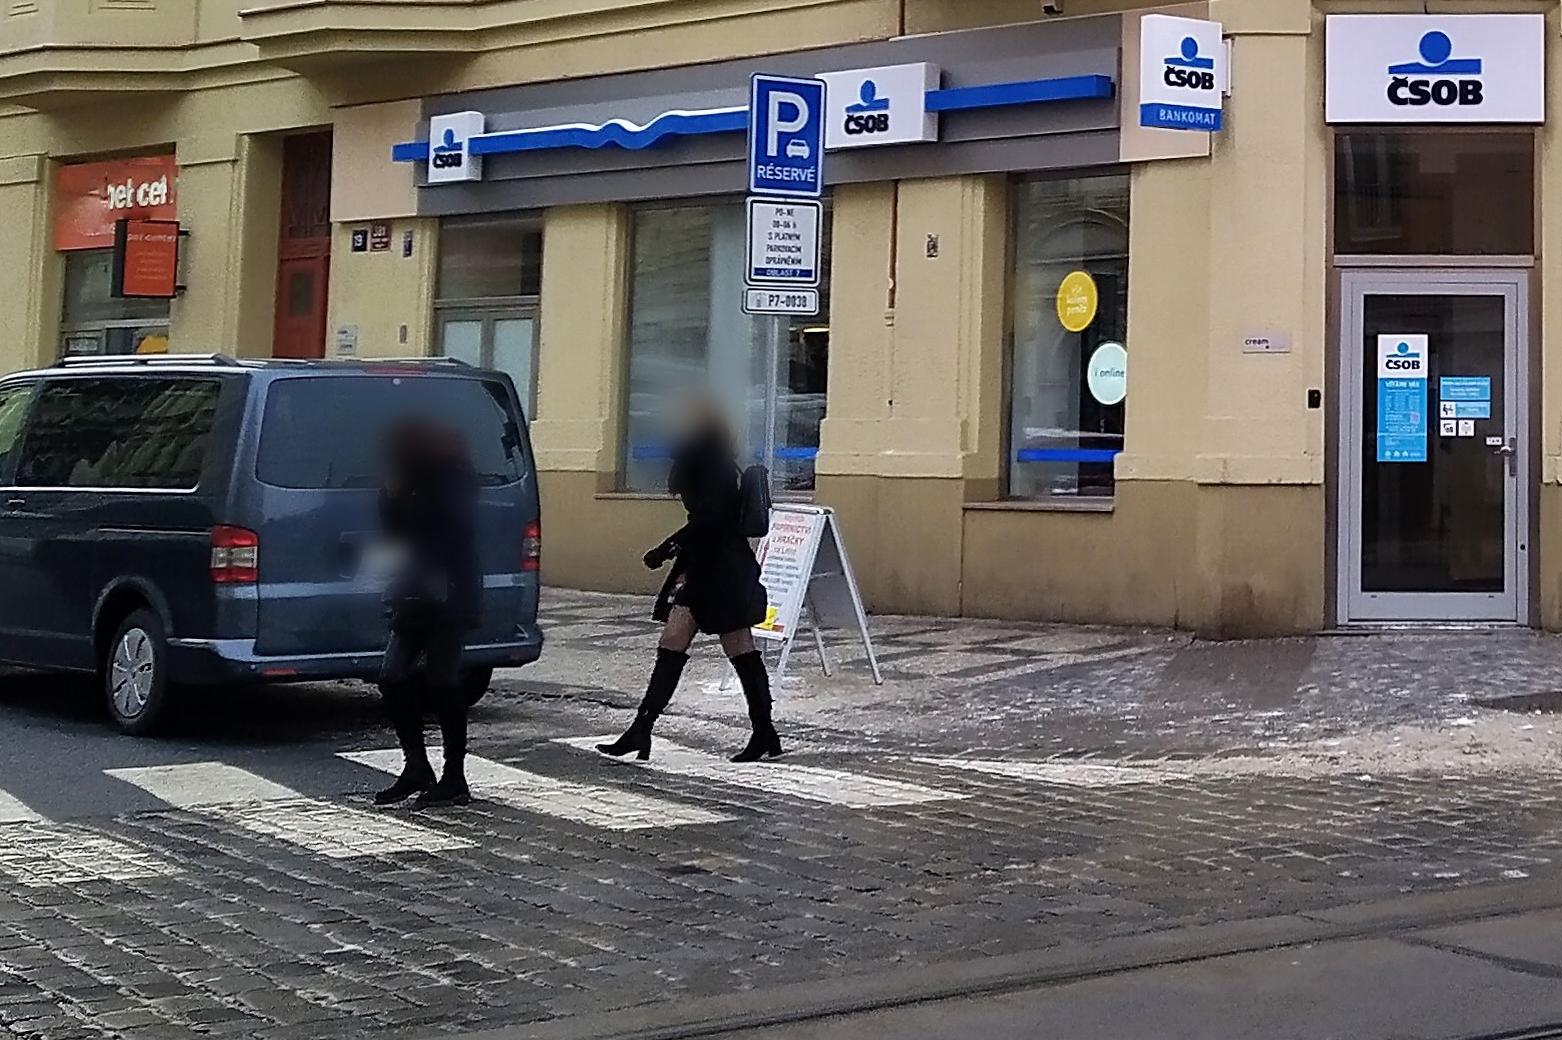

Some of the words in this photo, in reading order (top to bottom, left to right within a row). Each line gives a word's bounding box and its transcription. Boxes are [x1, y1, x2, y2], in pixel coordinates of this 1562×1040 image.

[1164, 65, 1215, 90] ČSOB
[1387, 76, 1484, 106] ČSOB
[766, 90, 810, 157] P
[844, 113, 890, 136] ČSOB
[1159, 108, 1216, 125] BANKOMAT
[756, 162, 817, 183] RÉSERVÉ
[767, 231, 773, 241] S
[766, 268, 792, 277] OBLAST
[1099, 366, 1125, 378] online
[1385, 359, 1421, 370] ČSOB
